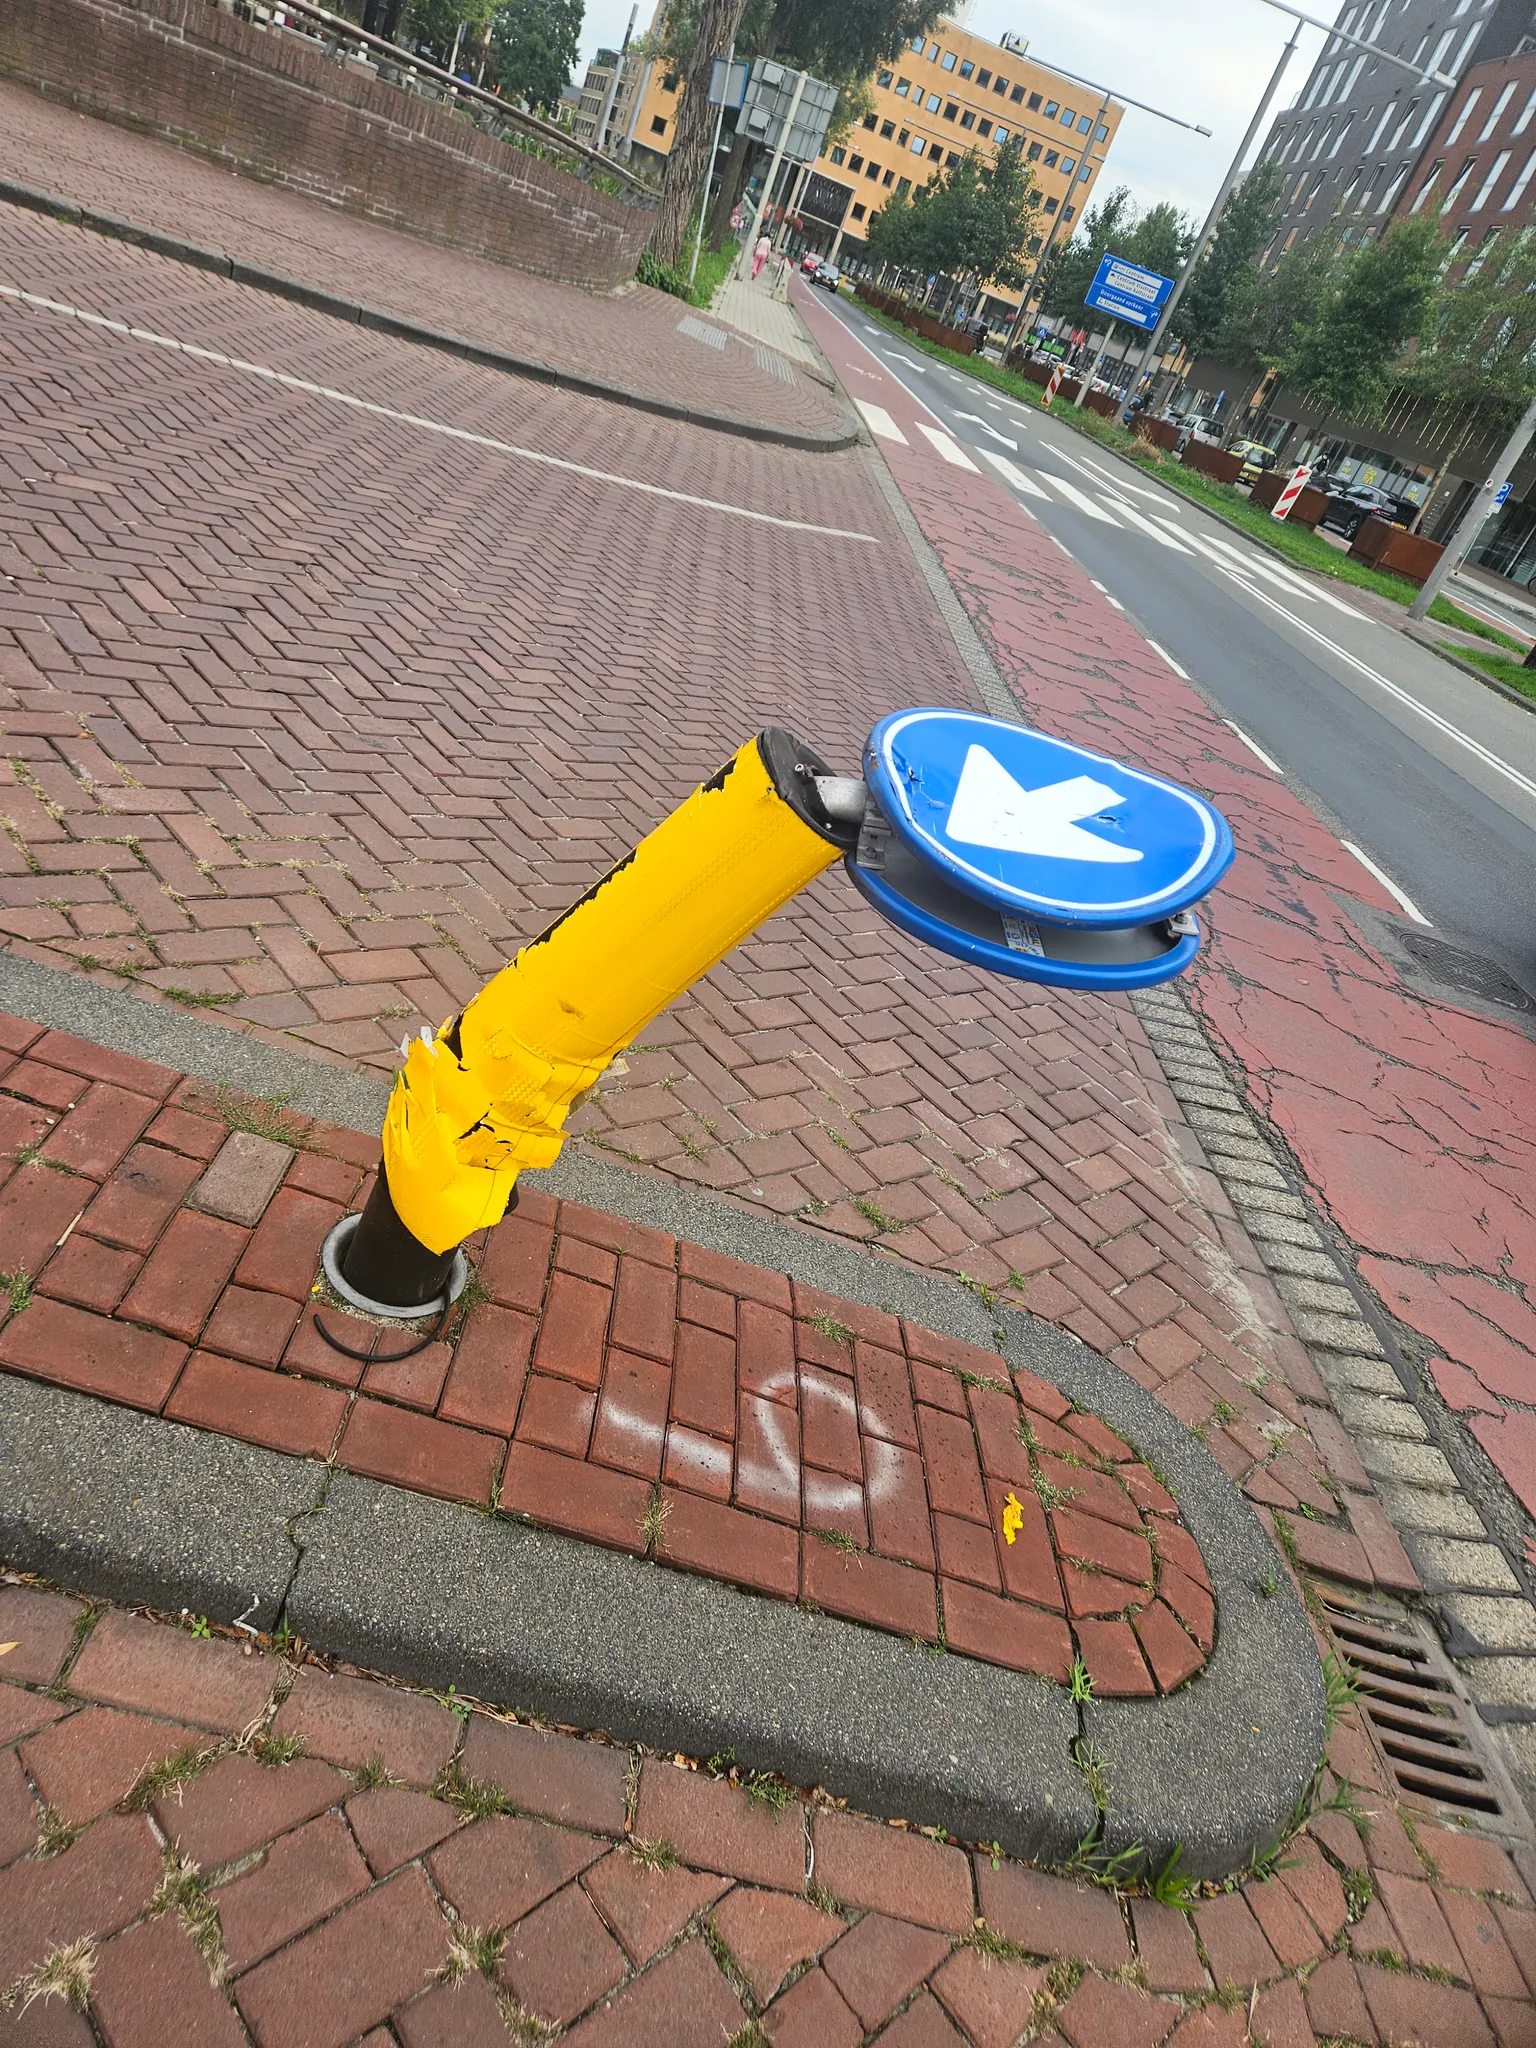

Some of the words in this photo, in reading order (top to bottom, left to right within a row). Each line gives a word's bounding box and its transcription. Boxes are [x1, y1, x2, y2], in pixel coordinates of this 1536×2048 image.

[1126, 268, 1145, 279] Centrum
[1115, 280, 1133, 291] Centrum
[1116, 274, 1135, 286] Centrum
[1100, 289, 1125, 303] Doorgaand
[1125, 300, 1144, 311] verkeer
[1103, 300, 1120, 310] Station
